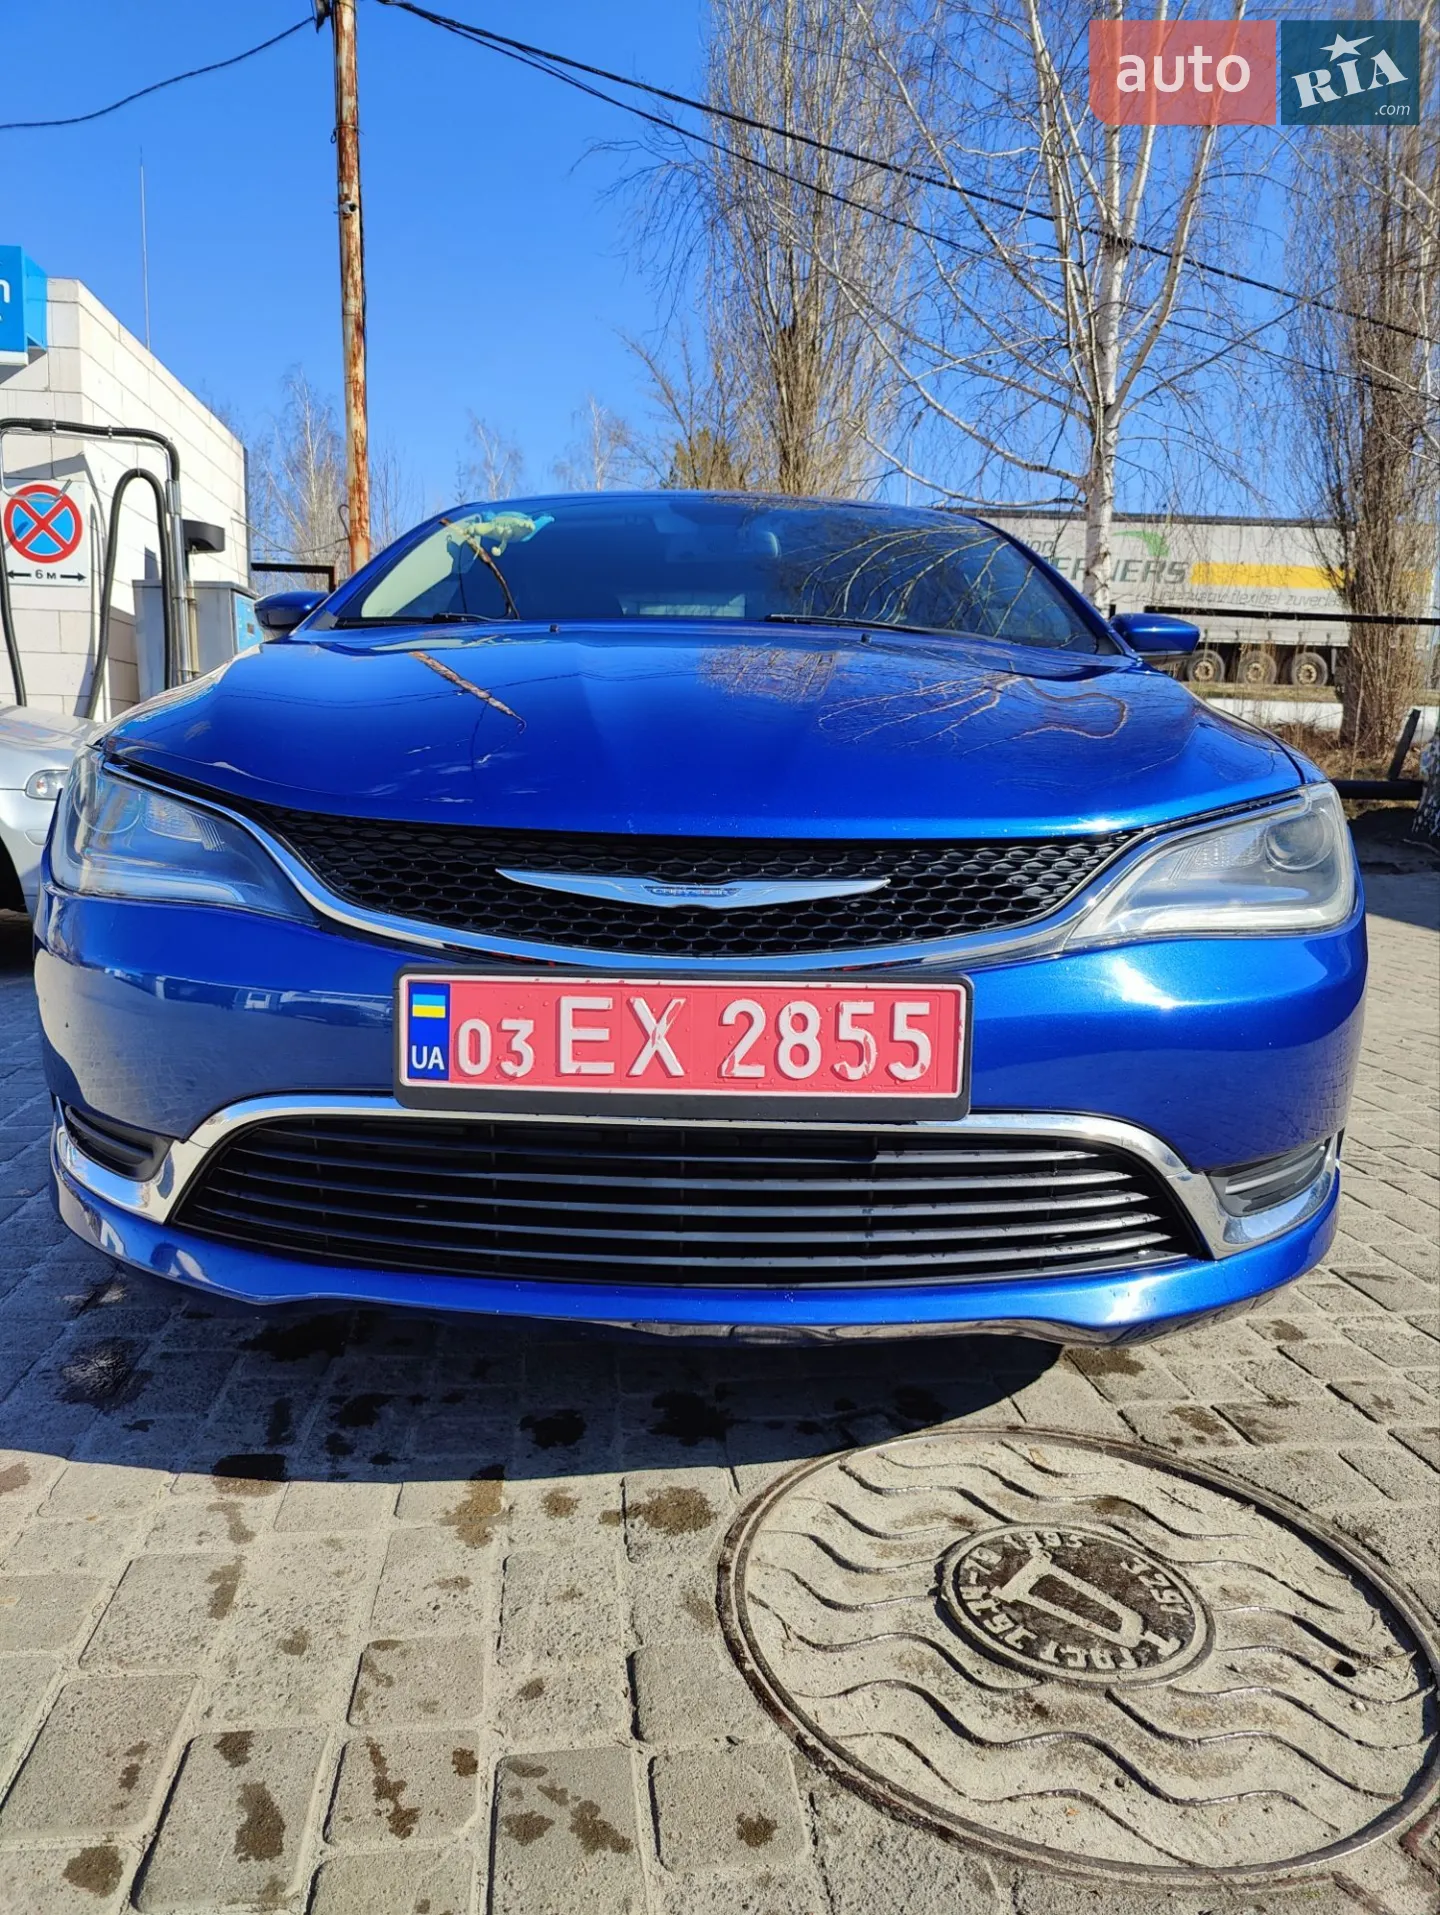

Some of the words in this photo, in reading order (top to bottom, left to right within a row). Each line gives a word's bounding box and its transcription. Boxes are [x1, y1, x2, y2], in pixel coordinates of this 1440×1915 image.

[35, 569, 44, 580] 6
[455, 1018, 536, 1077] 03
[559, 996, 686, 1078] EX
[717, 999, 932, 1080] 2855
[411, 1044, 446, 1070] UA
